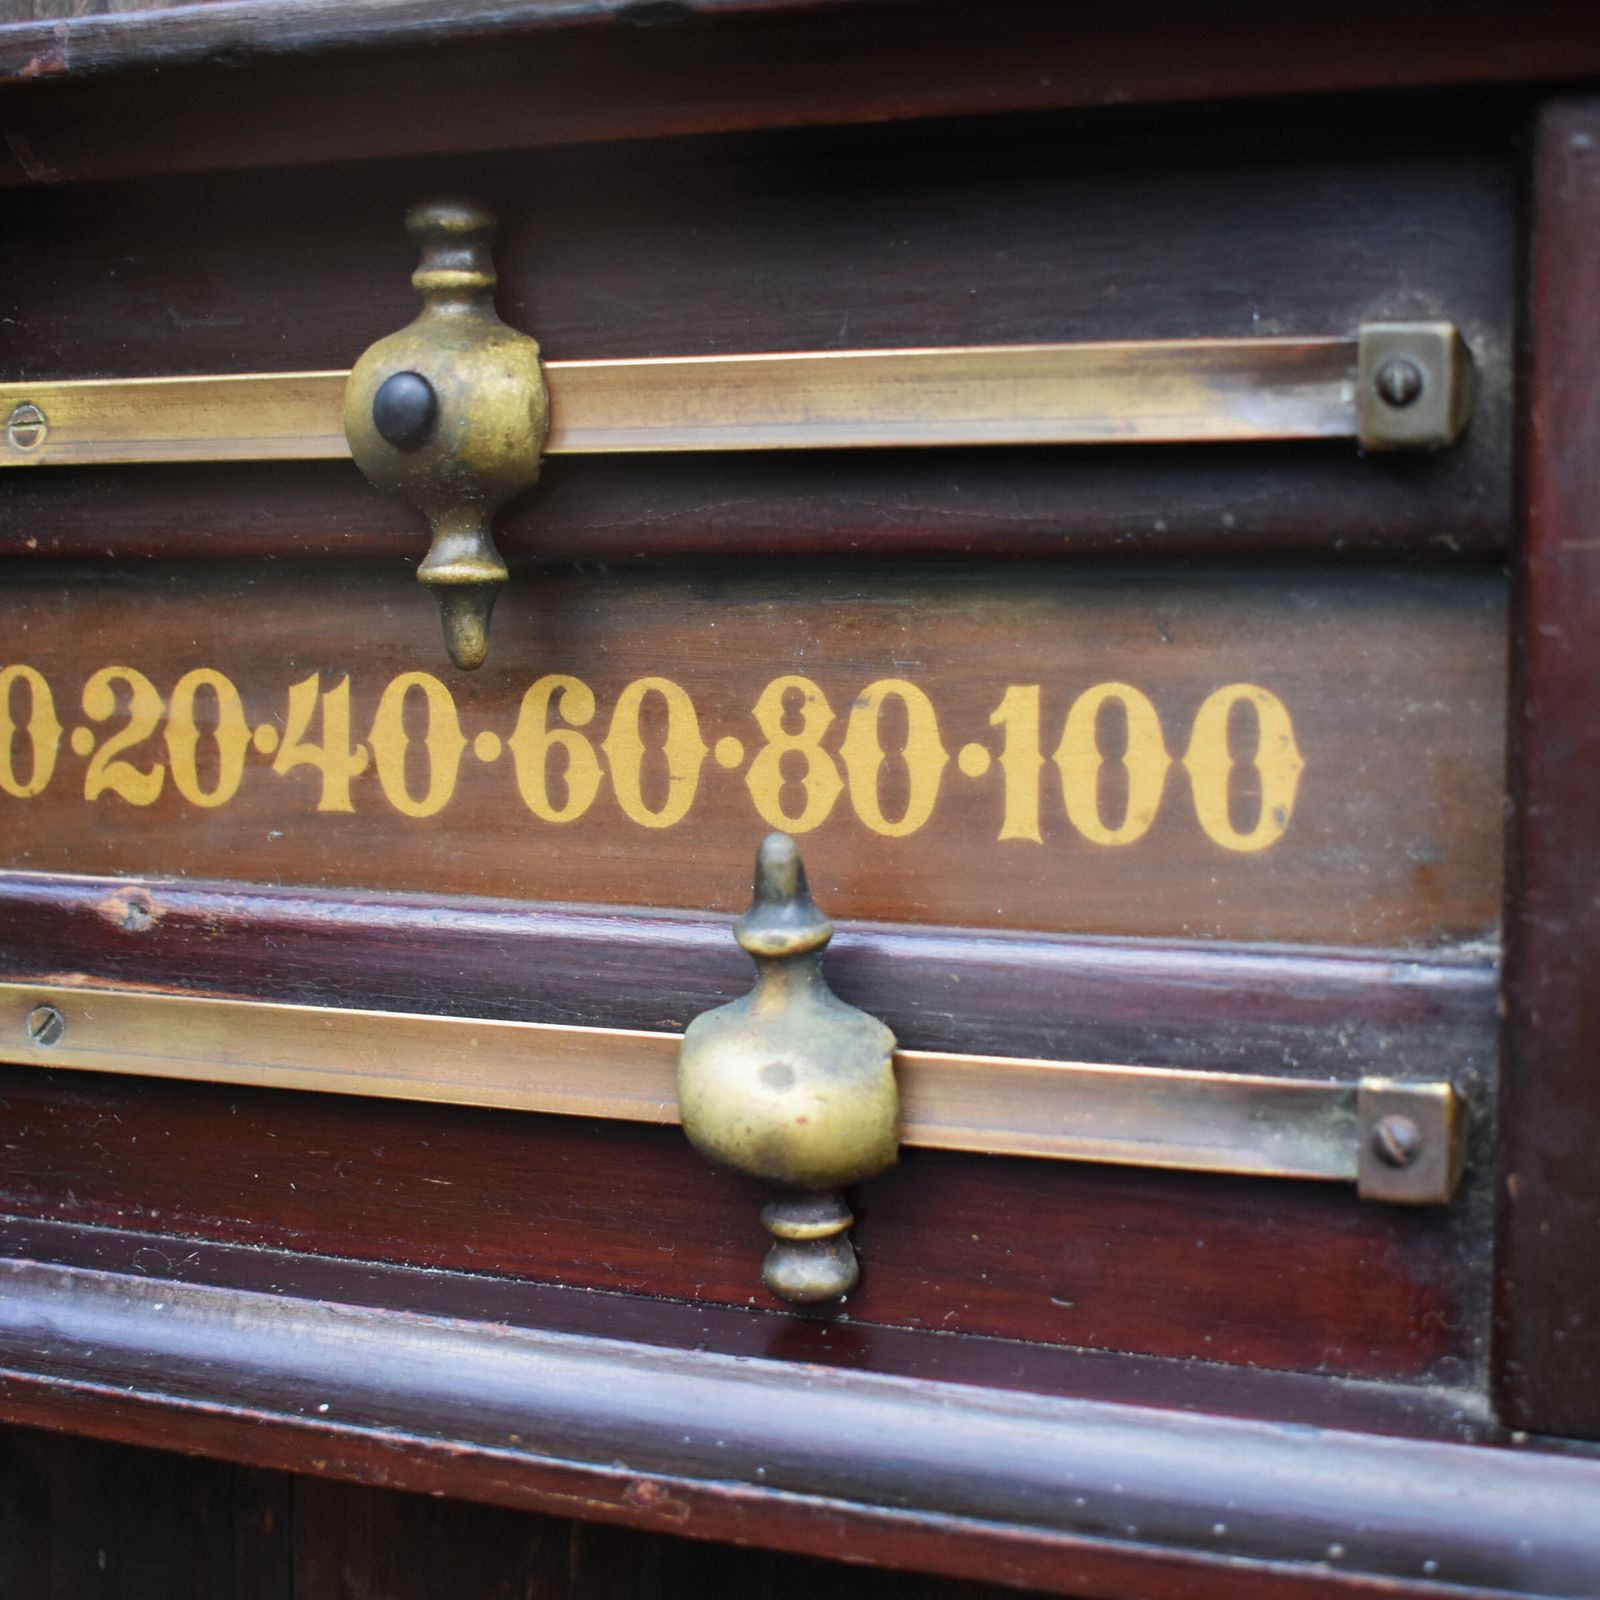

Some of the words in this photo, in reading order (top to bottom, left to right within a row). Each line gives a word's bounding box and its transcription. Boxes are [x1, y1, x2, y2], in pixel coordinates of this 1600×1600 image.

[0, 664, 63, 798] 0
[82, 666, 253, 808] 20
[272, 671, 468, 818] 40
[507, 674, 710, 829] 60
[745, 675, 950, 838] 80
[989, 682, 1305, 852] 100
